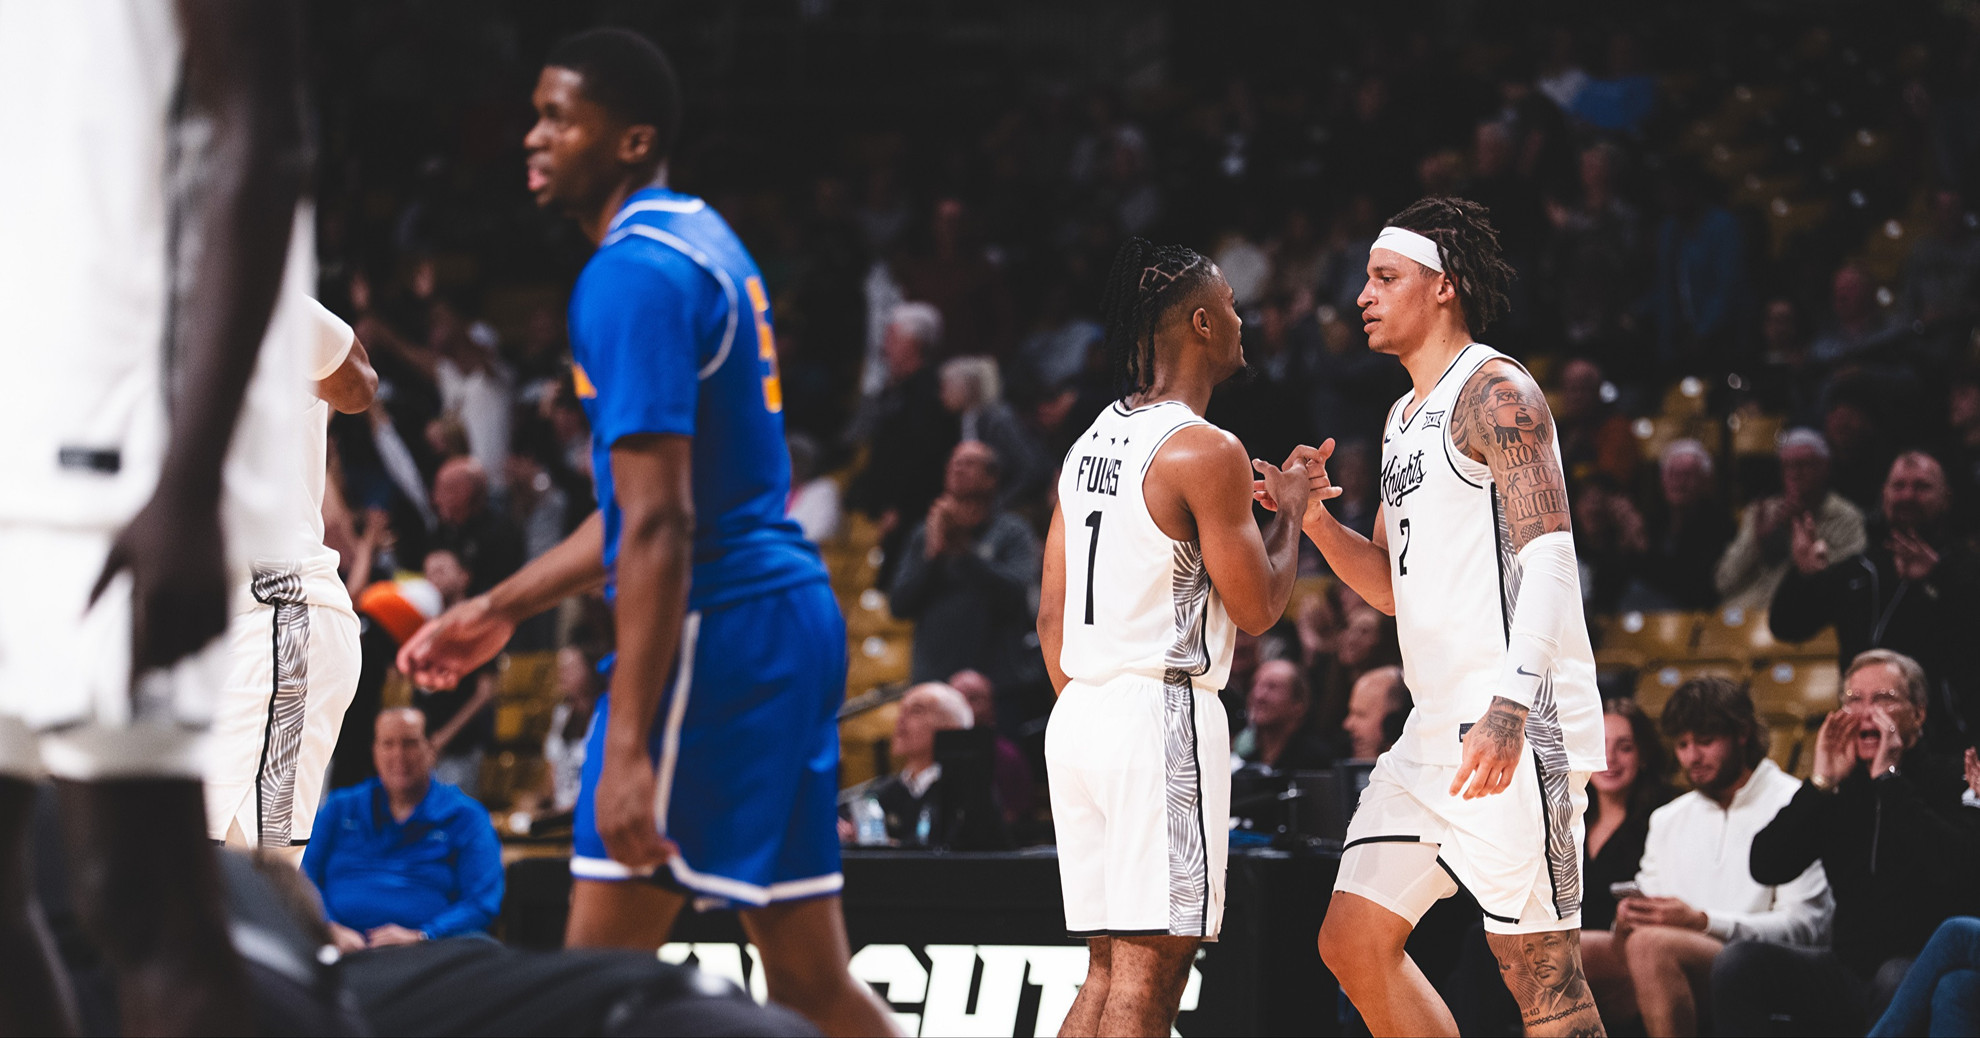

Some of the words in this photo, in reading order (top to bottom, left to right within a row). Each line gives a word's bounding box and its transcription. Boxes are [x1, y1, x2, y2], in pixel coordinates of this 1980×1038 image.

[1076, 456, 1122, 496] FULKS
[1380, 449, 1427, 508] Knights
[1522, 464, 1552, 487] TO
[1084, 510, 1103, 625] 1
[1398, 518, 1411, 576] 2
